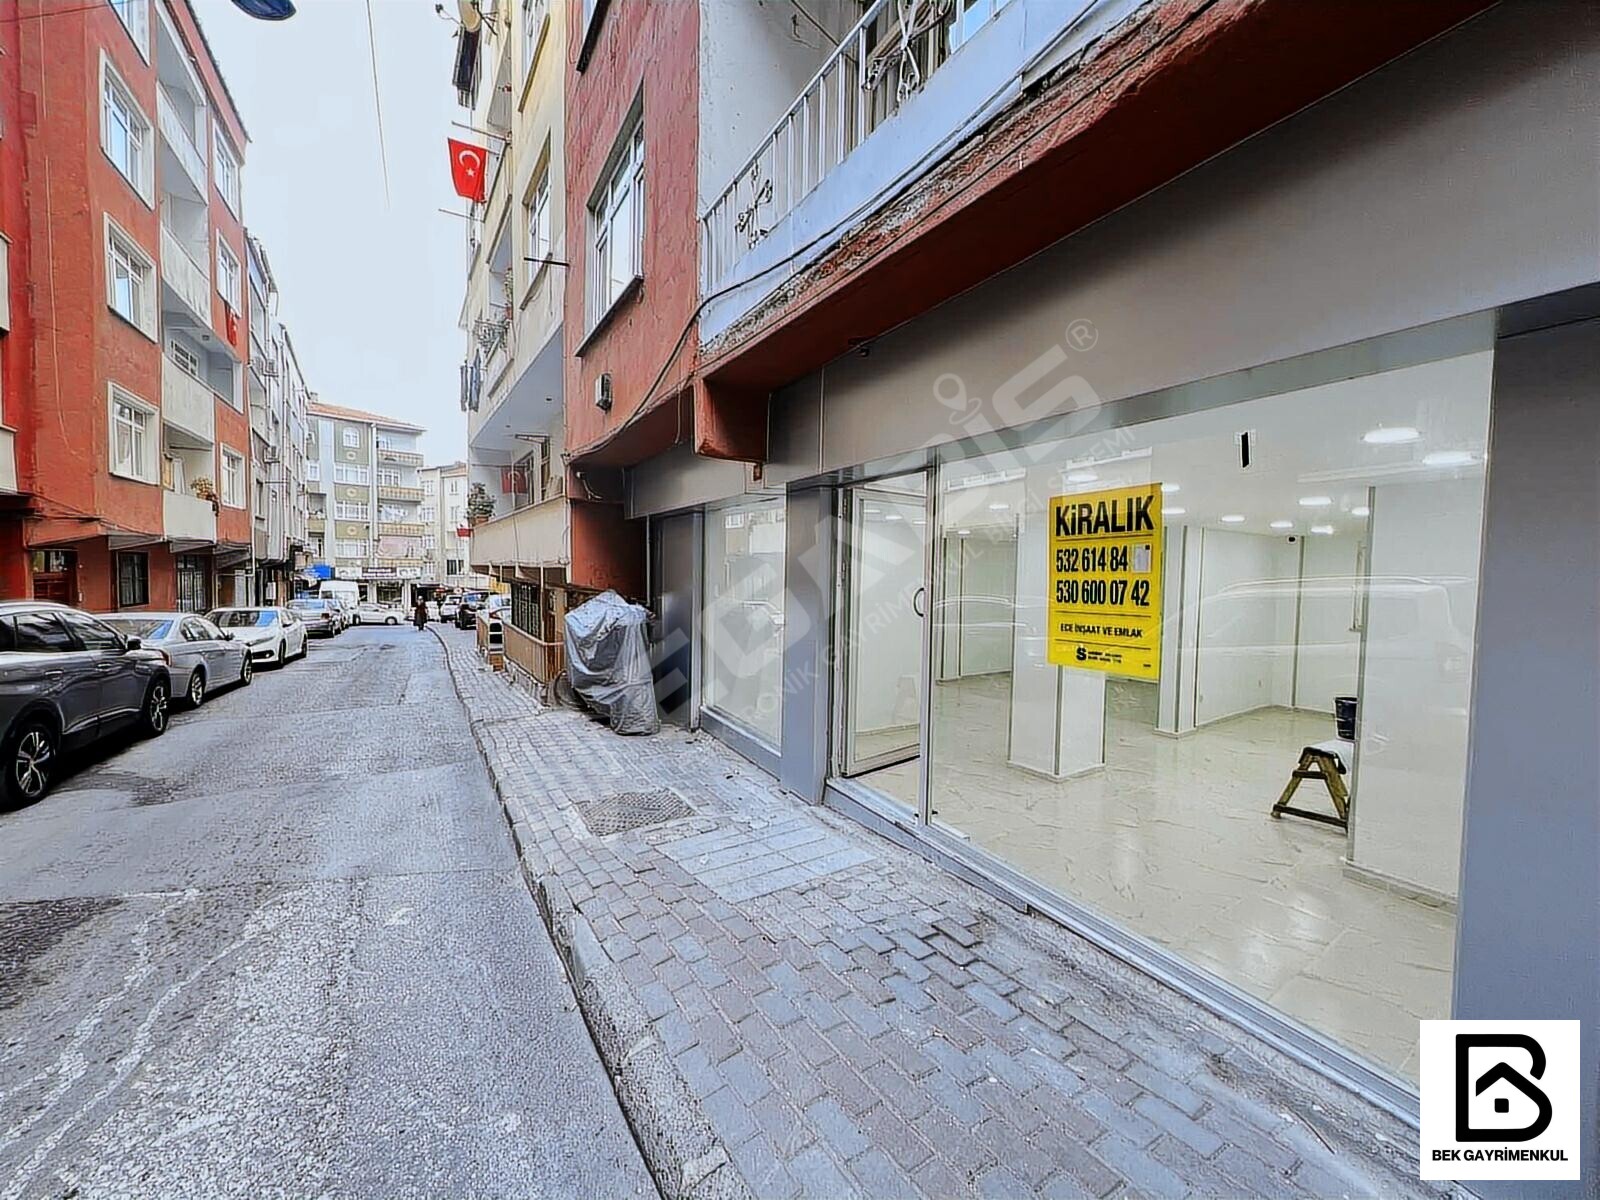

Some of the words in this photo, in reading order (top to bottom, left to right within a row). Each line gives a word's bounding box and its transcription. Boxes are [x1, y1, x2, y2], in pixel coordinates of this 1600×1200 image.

[1056, 548, 1079, 573] 532
[1082, 546, 1107, 572] 614
[1110, 545, 1128, 572] 84
[1056, 579, 1079, 604] 530
[1082, 579, 1107, 605] 600
[1110, 580, 1128, 605] 07
[1131, 580, 1150, 607] 42
[1102, 626, 1113, 636] VE
[1114, 627, 1143, 638] EMLAK
